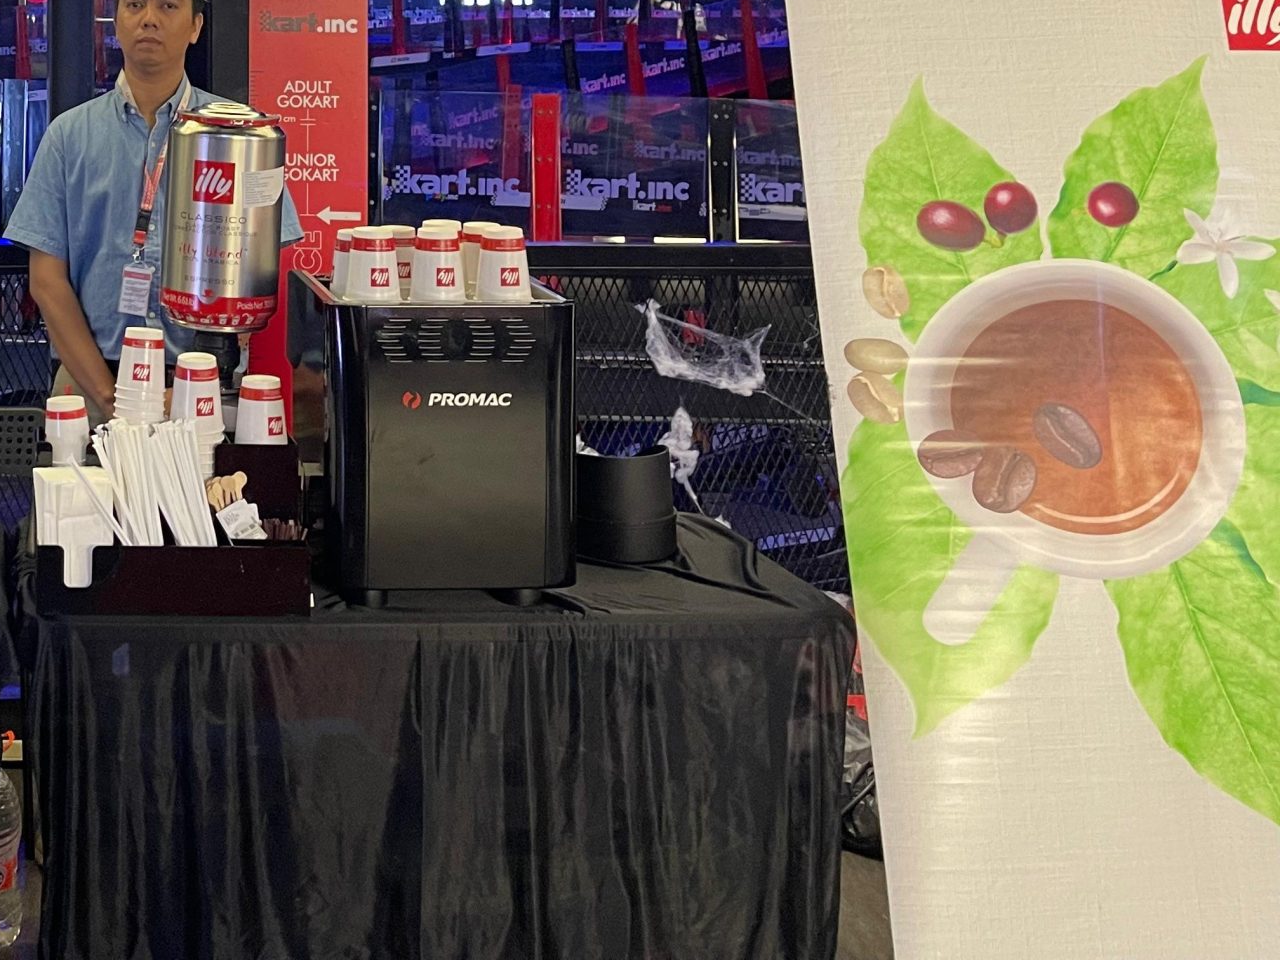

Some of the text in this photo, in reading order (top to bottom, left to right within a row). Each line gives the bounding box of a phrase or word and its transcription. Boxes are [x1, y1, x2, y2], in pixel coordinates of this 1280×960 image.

[260, 10, 358, 33] kart.inc
[643, 56, 685, 79] kart.inc
[283, 80, 332, 94] ADULT
[580, 72, 626, 94] kart.inc
[276, 95, 339, 109] GOKART
[285, 153, 336, 167] UNIOR
[195, 167, 233, 200] illy
[395, 165, 520, 195] kart.inc
[566, 169, 690, 201] kart.inc
[180, 211, 248, 225] CLASSICO
[428, 392, 513, 407] PROMAC
